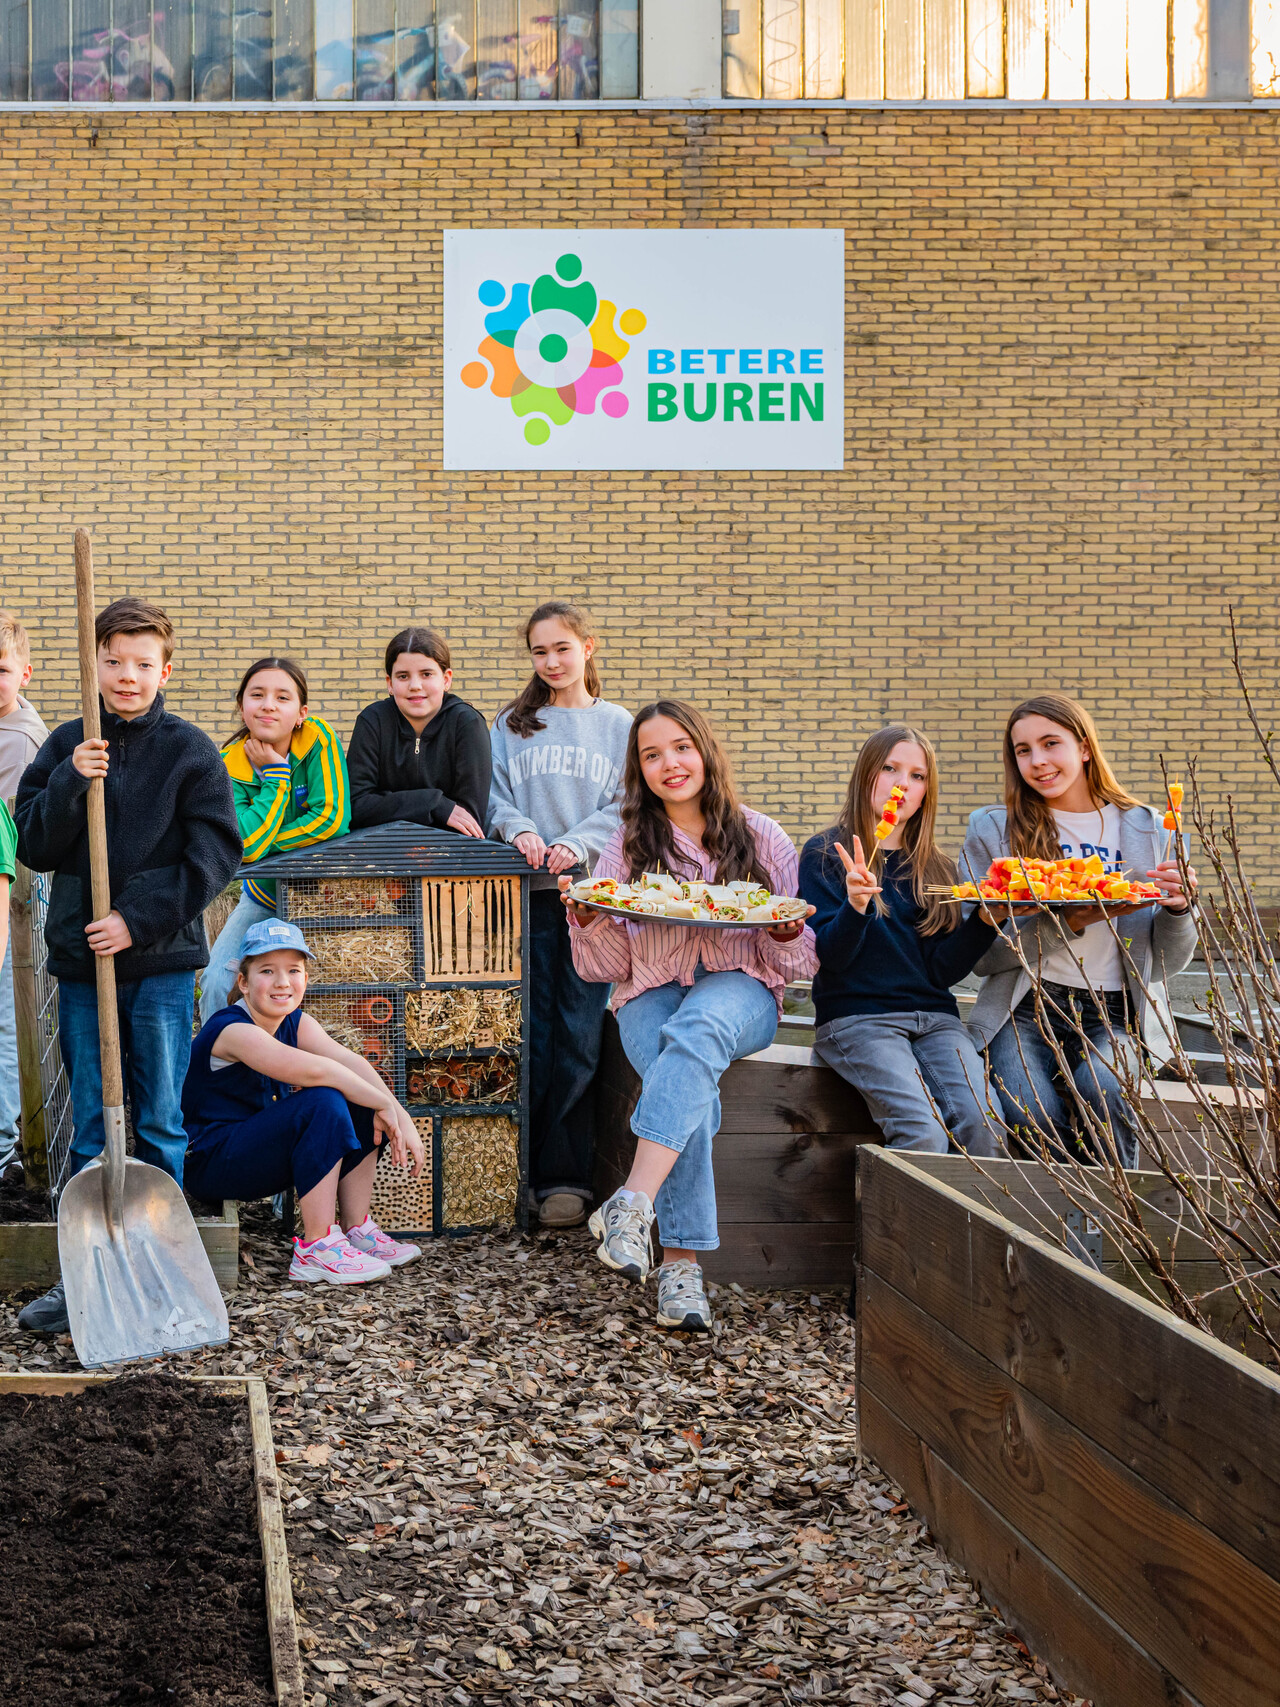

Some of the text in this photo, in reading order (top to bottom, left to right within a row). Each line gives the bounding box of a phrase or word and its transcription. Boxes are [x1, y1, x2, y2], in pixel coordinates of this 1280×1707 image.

[648, 349, 824, 374] BETERE
[648, 382, 824, 422] BUREN
[508, 745, 619, 799] NUMBER ONE
